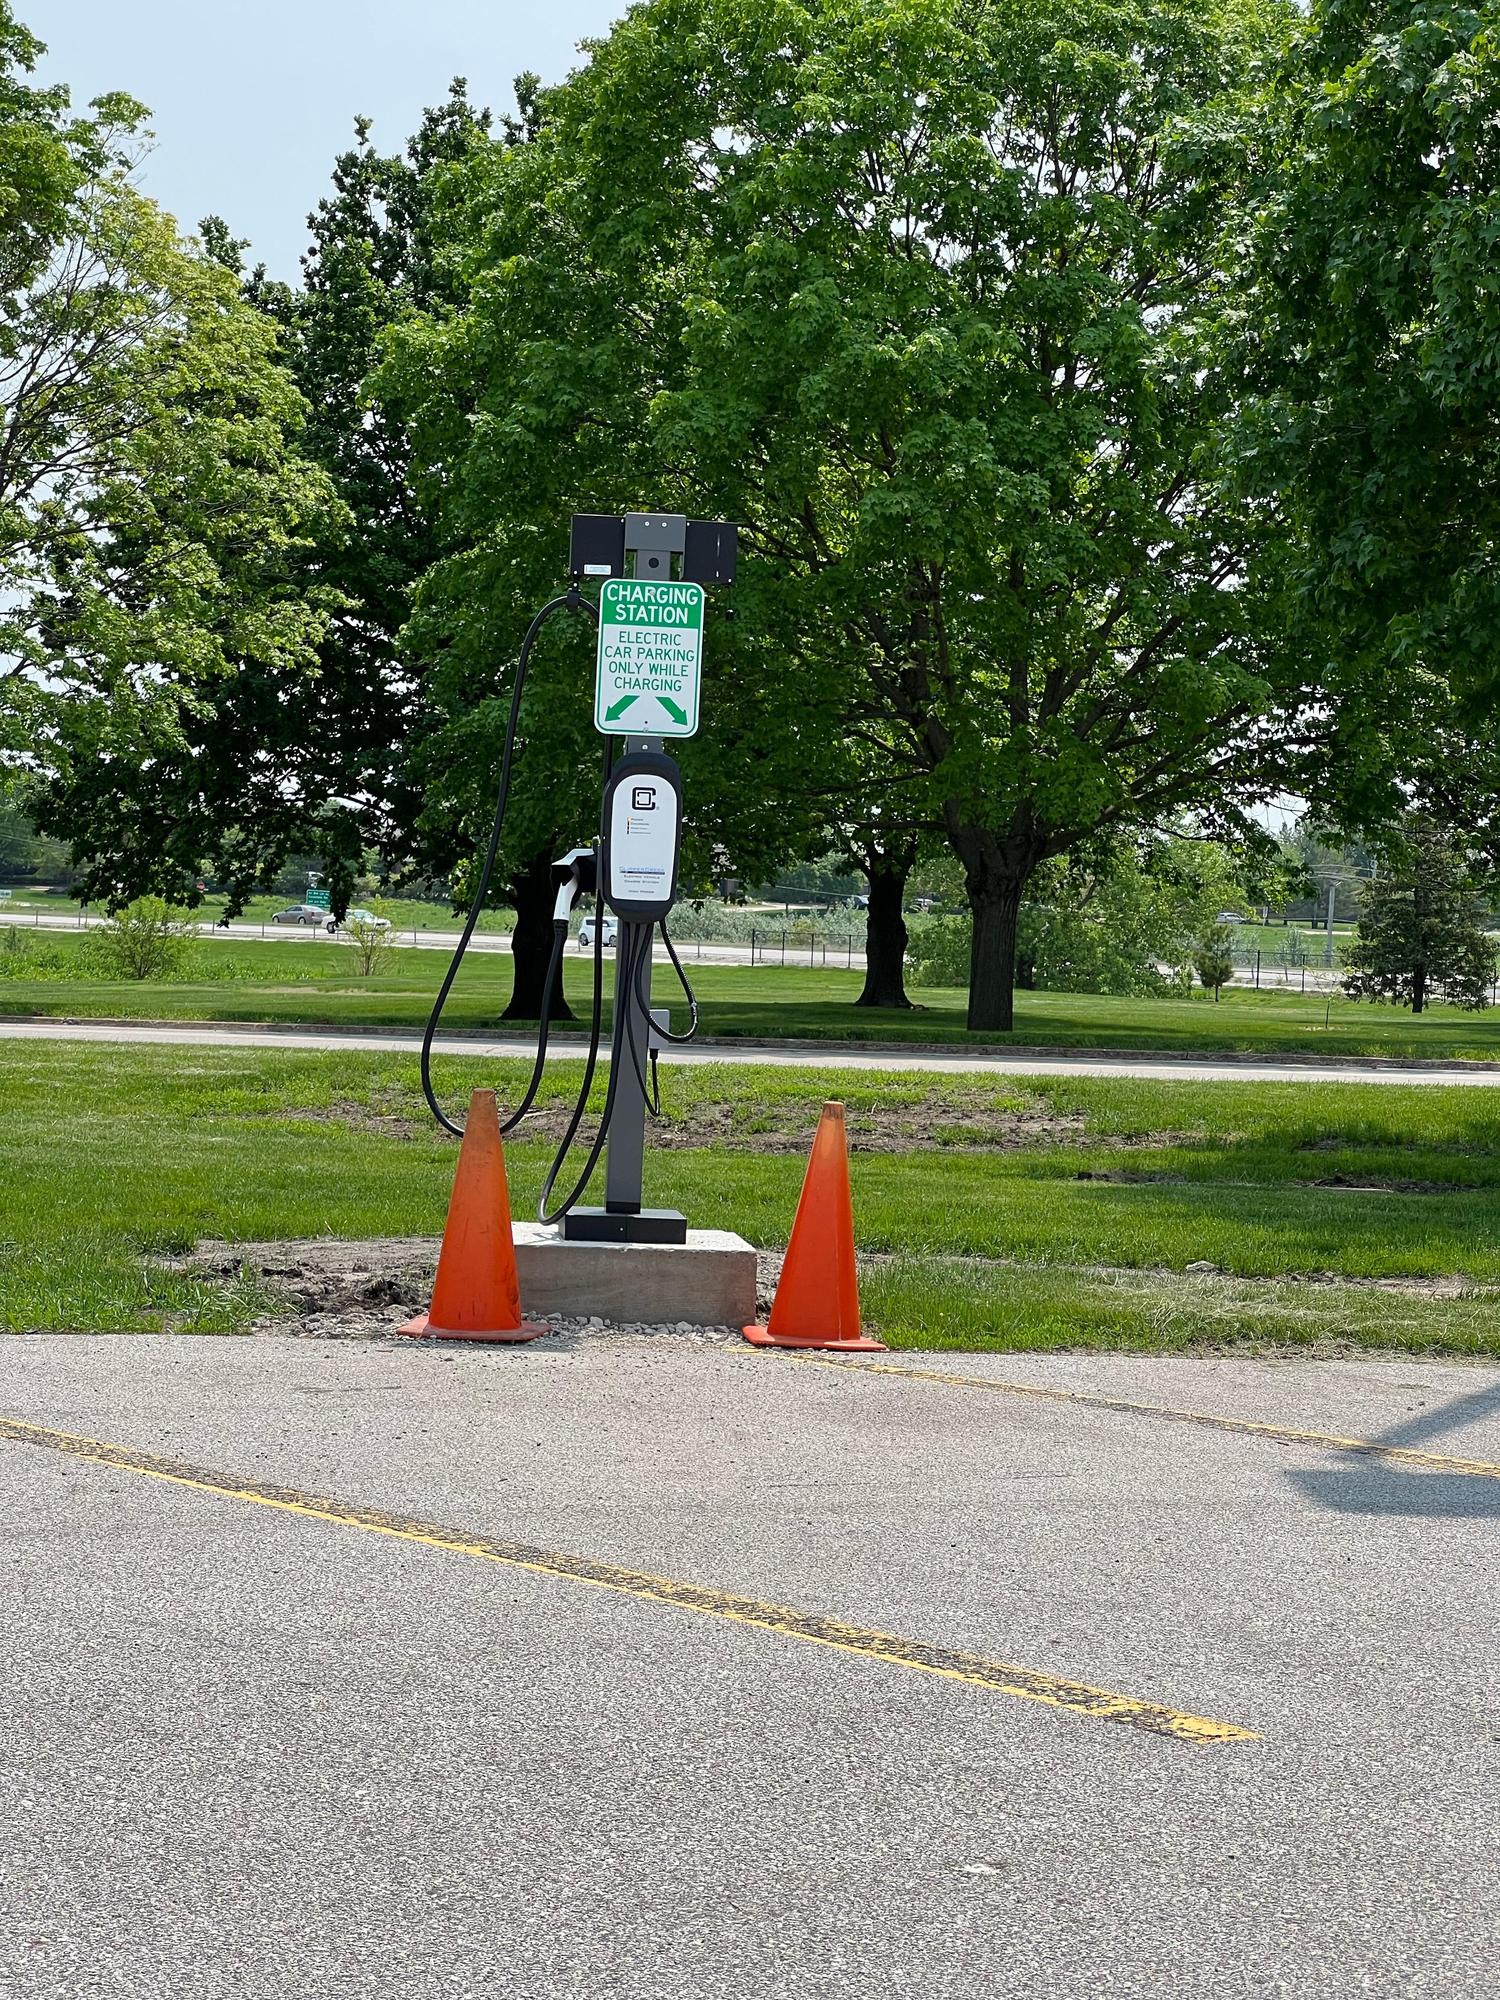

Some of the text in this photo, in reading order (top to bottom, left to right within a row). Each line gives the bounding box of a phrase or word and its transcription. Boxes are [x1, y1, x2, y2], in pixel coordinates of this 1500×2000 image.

[607, 584, 698, 606] CHARGING
[615, 604, 688, 624] STATION
[619, 631, 682, 646] ELECTRIC
[605, 646, 695, 662] CAR PARKING
[608, 661, 689, 677] ONLY WHILE
[614, 677, 682, 692] CHARGING
